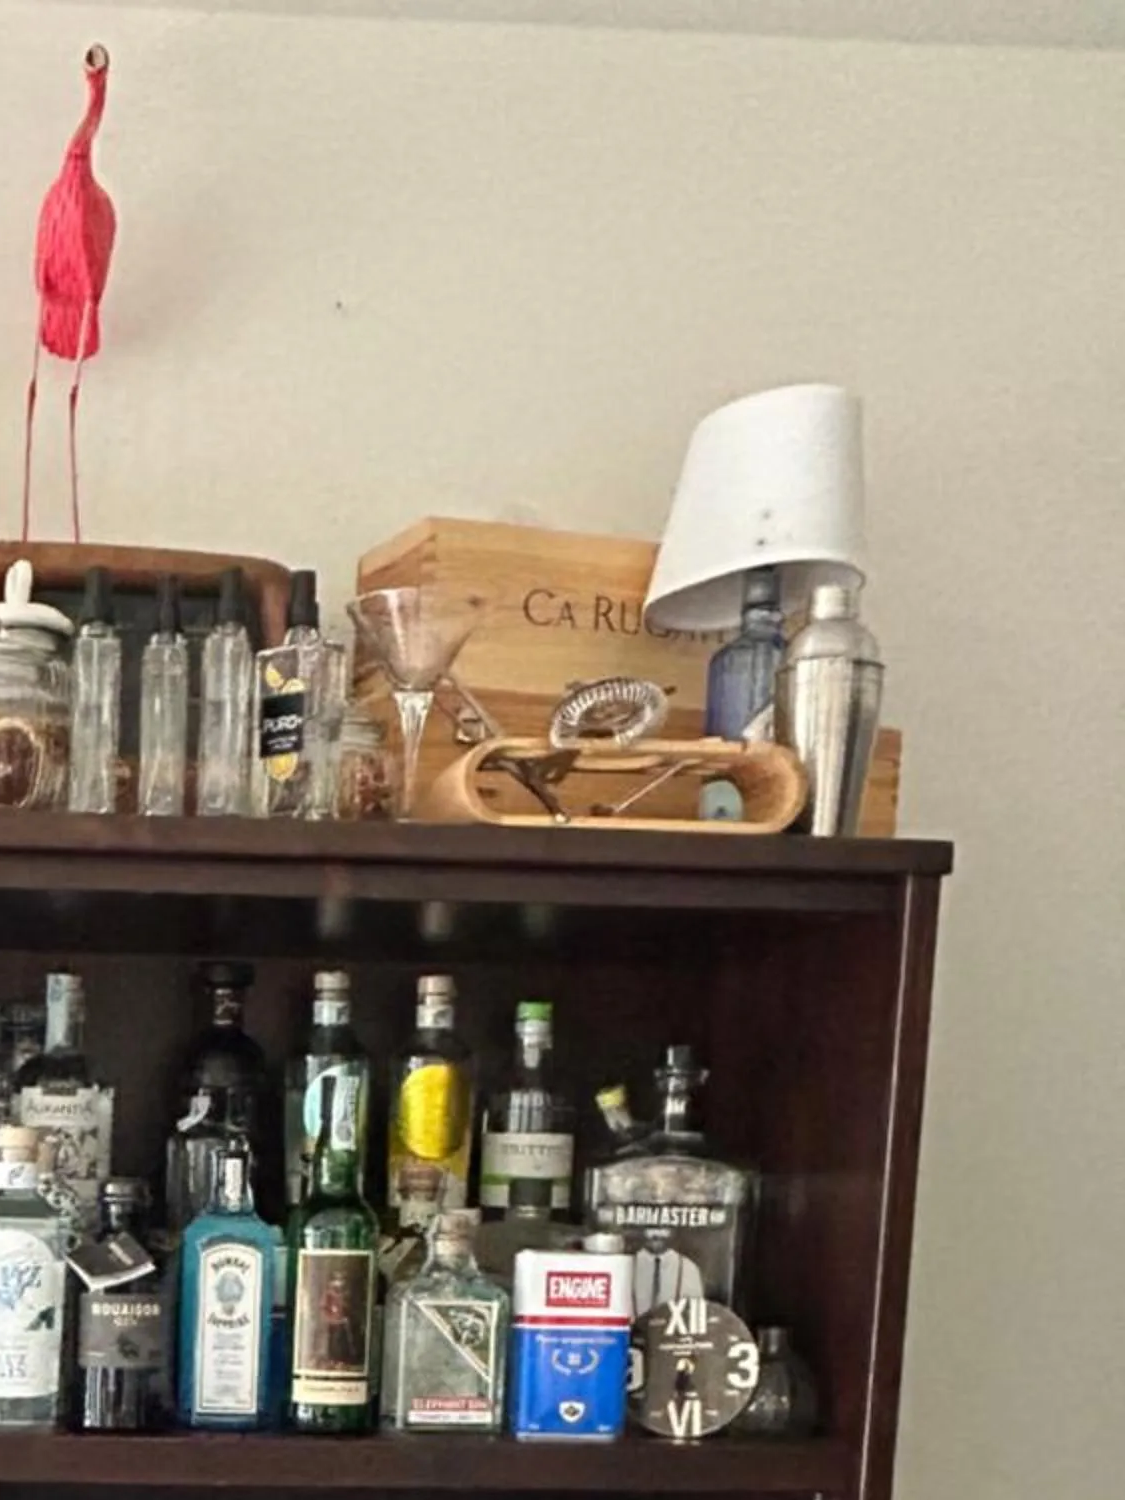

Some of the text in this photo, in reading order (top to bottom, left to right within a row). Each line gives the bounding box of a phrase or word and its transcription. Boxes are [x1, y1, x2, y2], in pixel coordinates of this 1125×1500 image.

[615, 1205, 709, 1227] BARMASTER
[548, 1274, 608, 1301] ENGINE
[663, 1298, 708, 1335] XII
[727, 1342, 760, 1388] 3
[667, 1399, 702, 1437] VI
